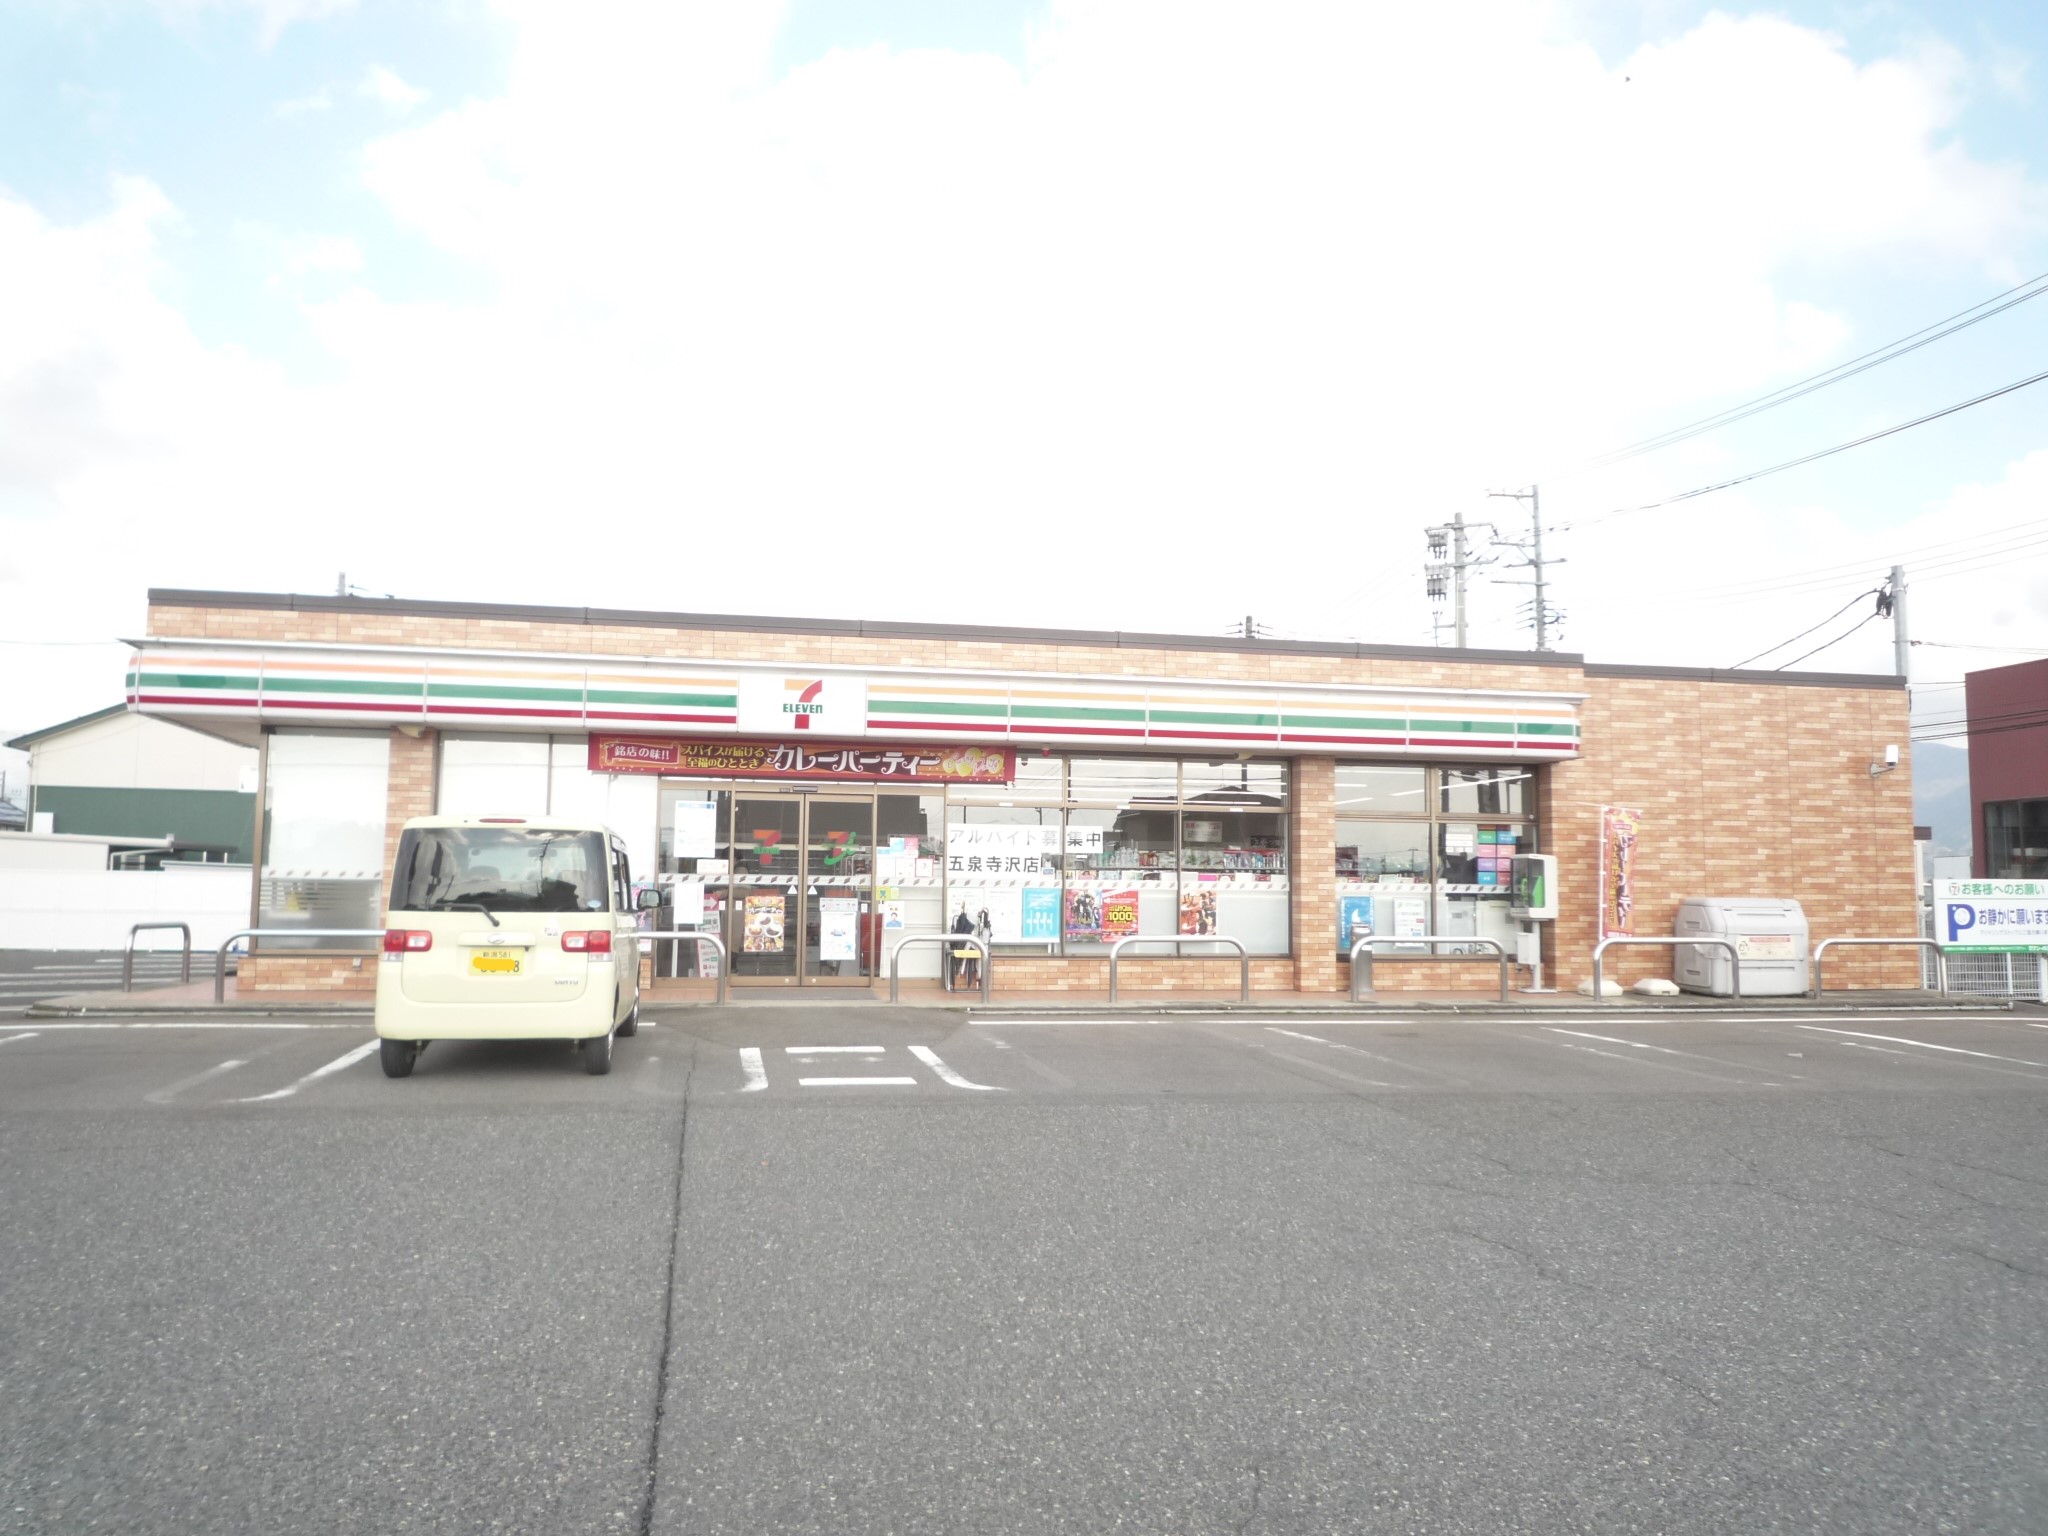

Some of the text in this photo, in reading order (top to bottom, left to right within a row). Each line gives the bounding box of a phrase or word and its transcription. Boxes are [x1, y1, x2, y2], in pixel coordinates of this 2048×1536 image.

[681, 744, 766, 757] スパイスが届ける
[766, 743, 941, 776] カレーパーティー
[948, 855, 1040, 873] 五泉寺沢店
[1961, 883, 2045, 896] お客様へのお願い
[1947, 903, 1976, 942] P
